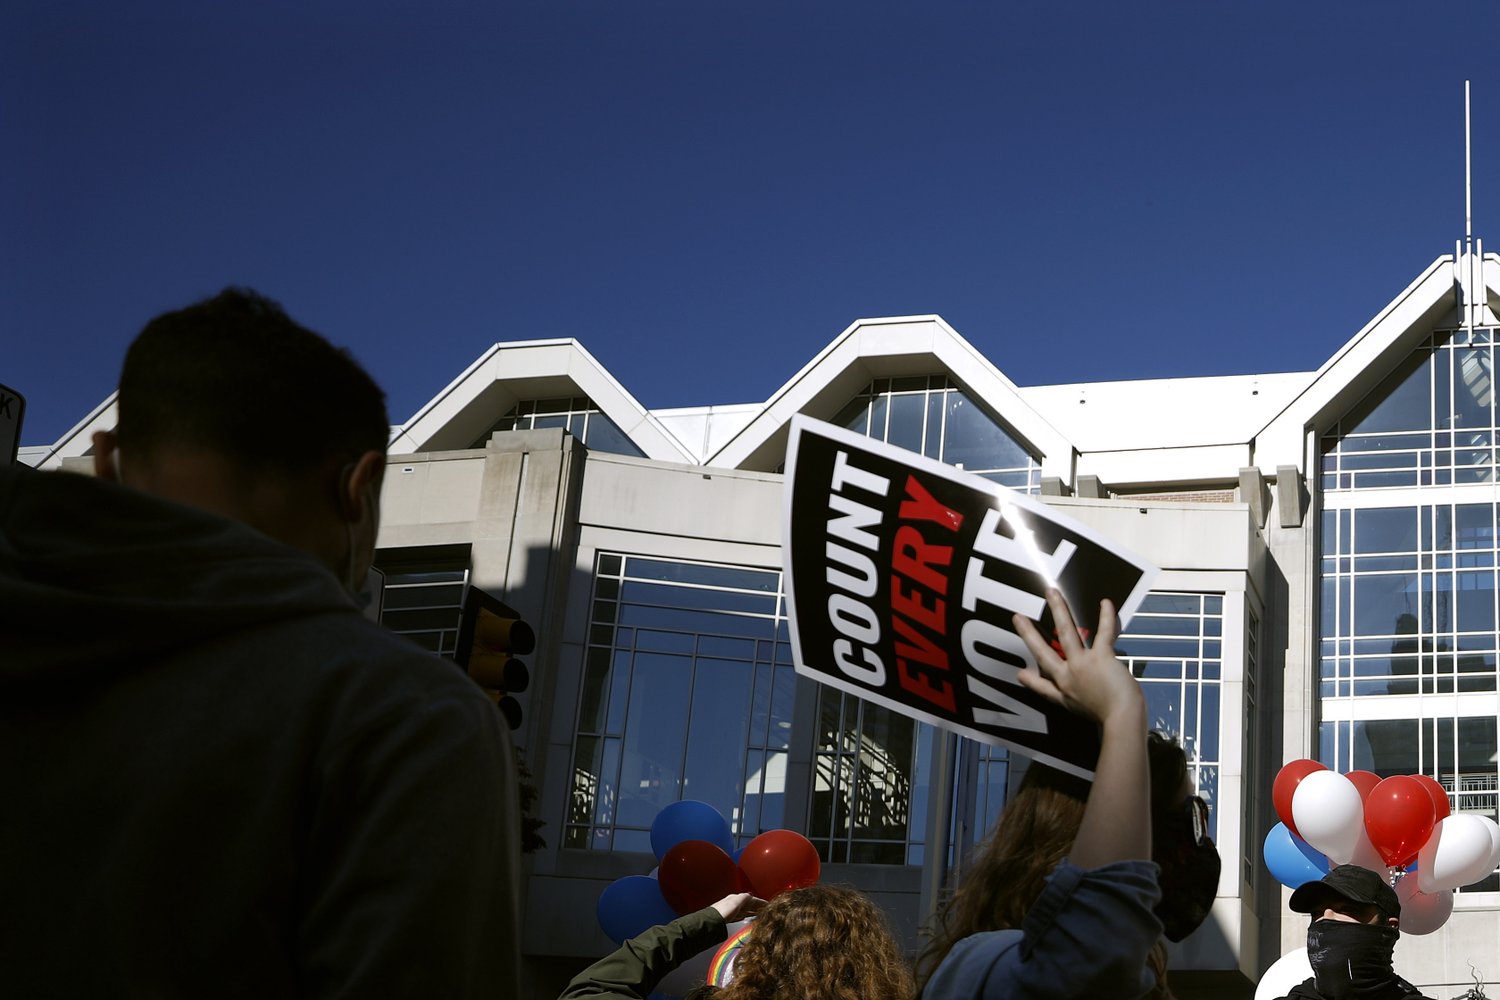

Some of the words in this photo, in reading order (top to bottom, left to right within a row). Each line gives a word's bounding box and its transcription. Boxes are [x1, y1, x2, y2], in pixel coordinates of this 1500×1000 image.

[826, 450, 891, 688] COUNT
[891, 475, 964, 713] EVERY
[960, 507, 1078, 734] VOTE
